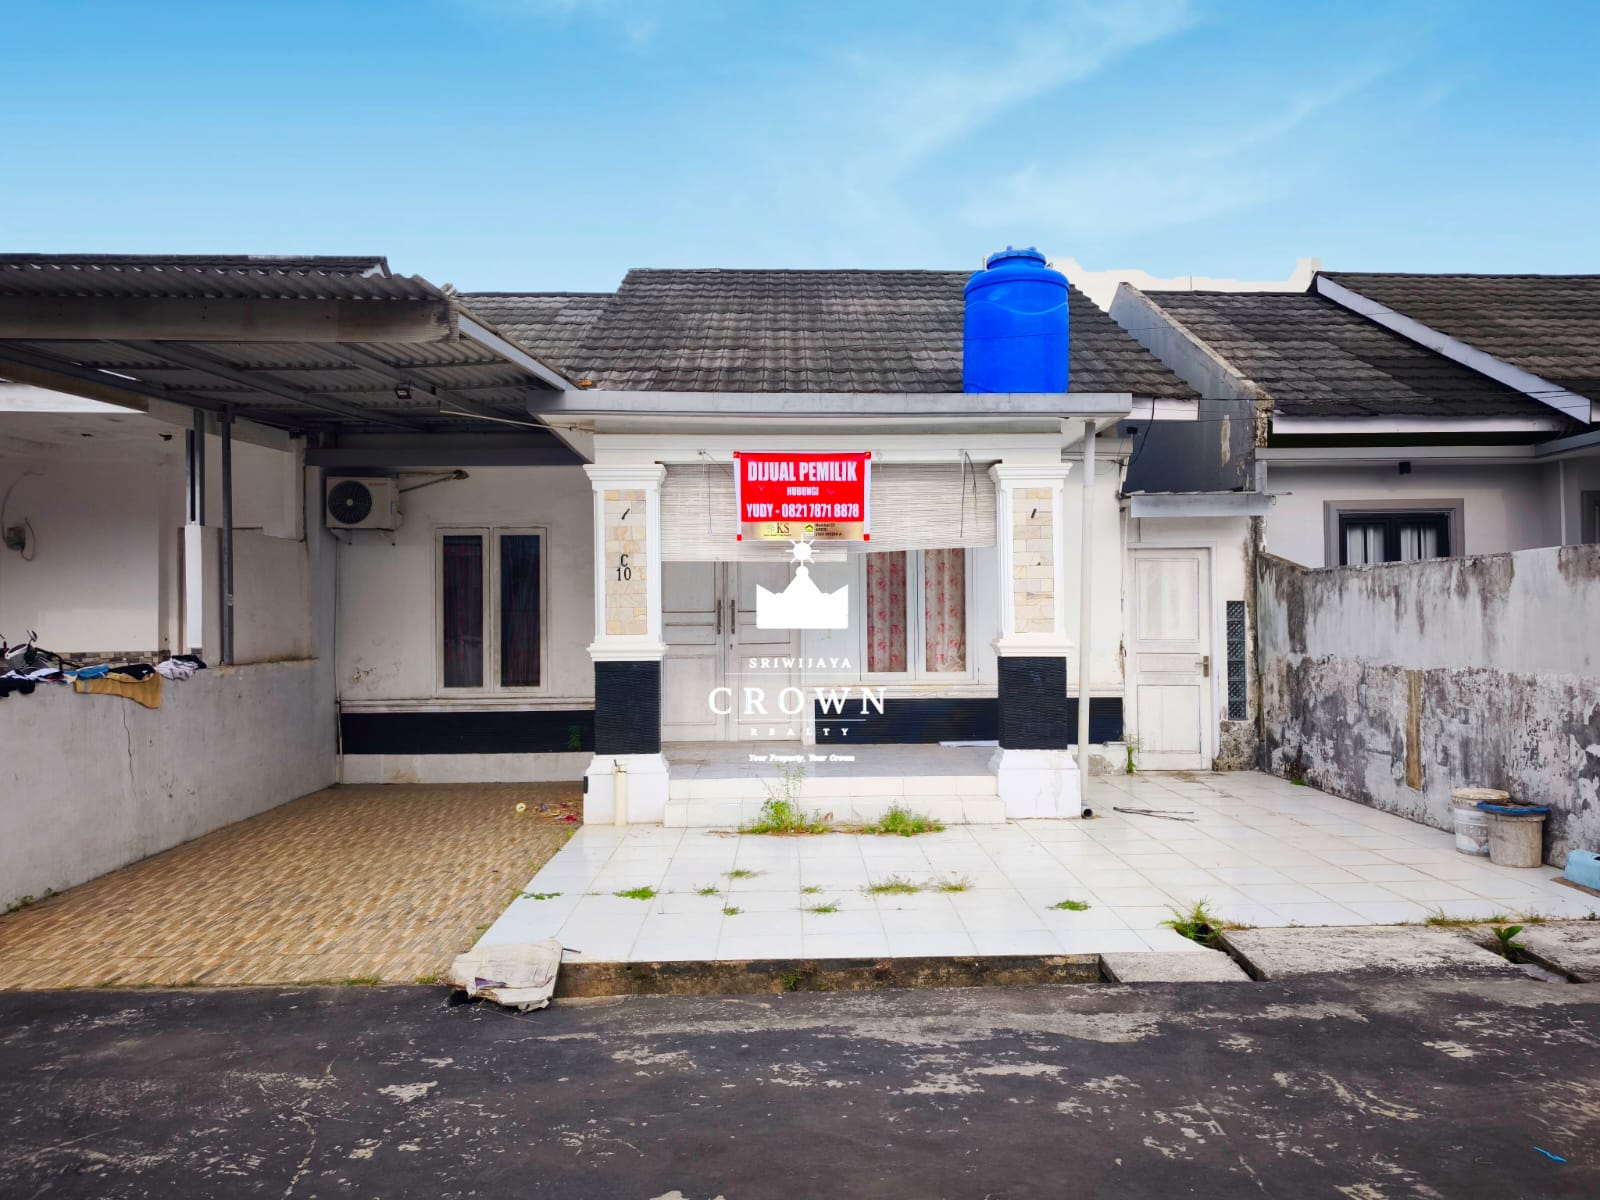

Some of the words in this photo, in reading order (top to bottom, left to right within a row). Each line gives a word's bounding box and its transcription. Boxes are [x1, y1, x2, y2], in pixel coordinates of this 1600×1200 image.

[748, 461, 796, 482] DIJUAL
[799, 461, 858, 482] PEMILIK
[786, 486, 819, 496] HUBUNGI
[746, 503, 774, 518] YUDY
[781, 503, 807, 518] 0821
[809, 503, 832, 518] 7871
[620, 553, 629, 567] C
[615, 567, 632, 581] 10
